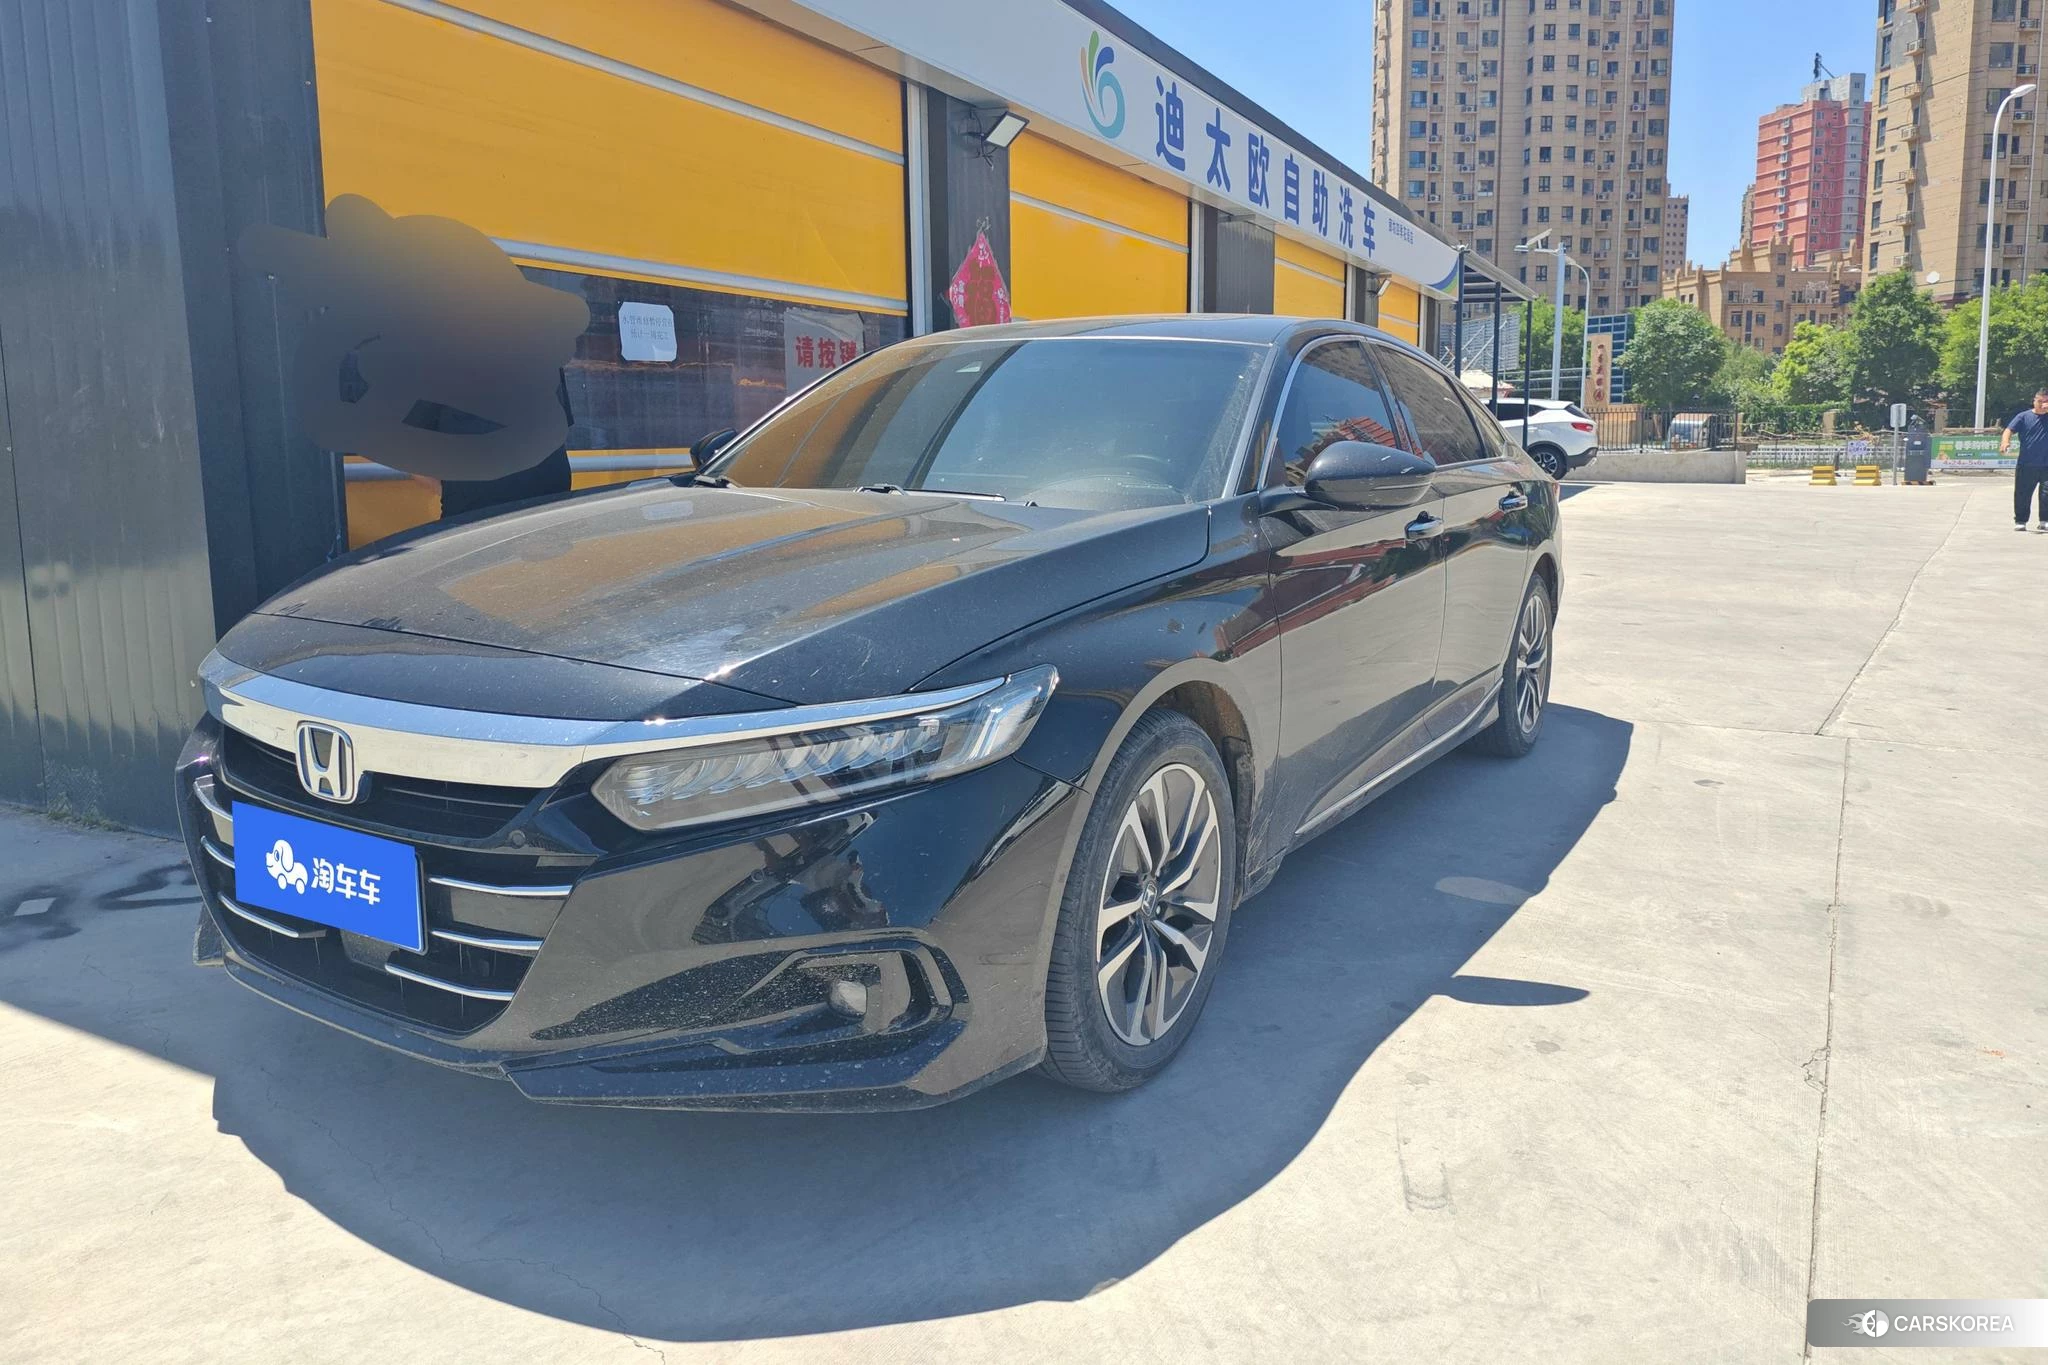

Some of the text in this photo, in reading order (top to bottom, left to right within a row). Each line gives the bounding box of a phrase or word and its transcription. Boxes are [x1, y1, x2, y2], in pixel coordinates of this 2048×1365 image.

[1155, 75, 1376, 258] 迪太欧自助洗车
[795, 336, 857, 368] 请按键
